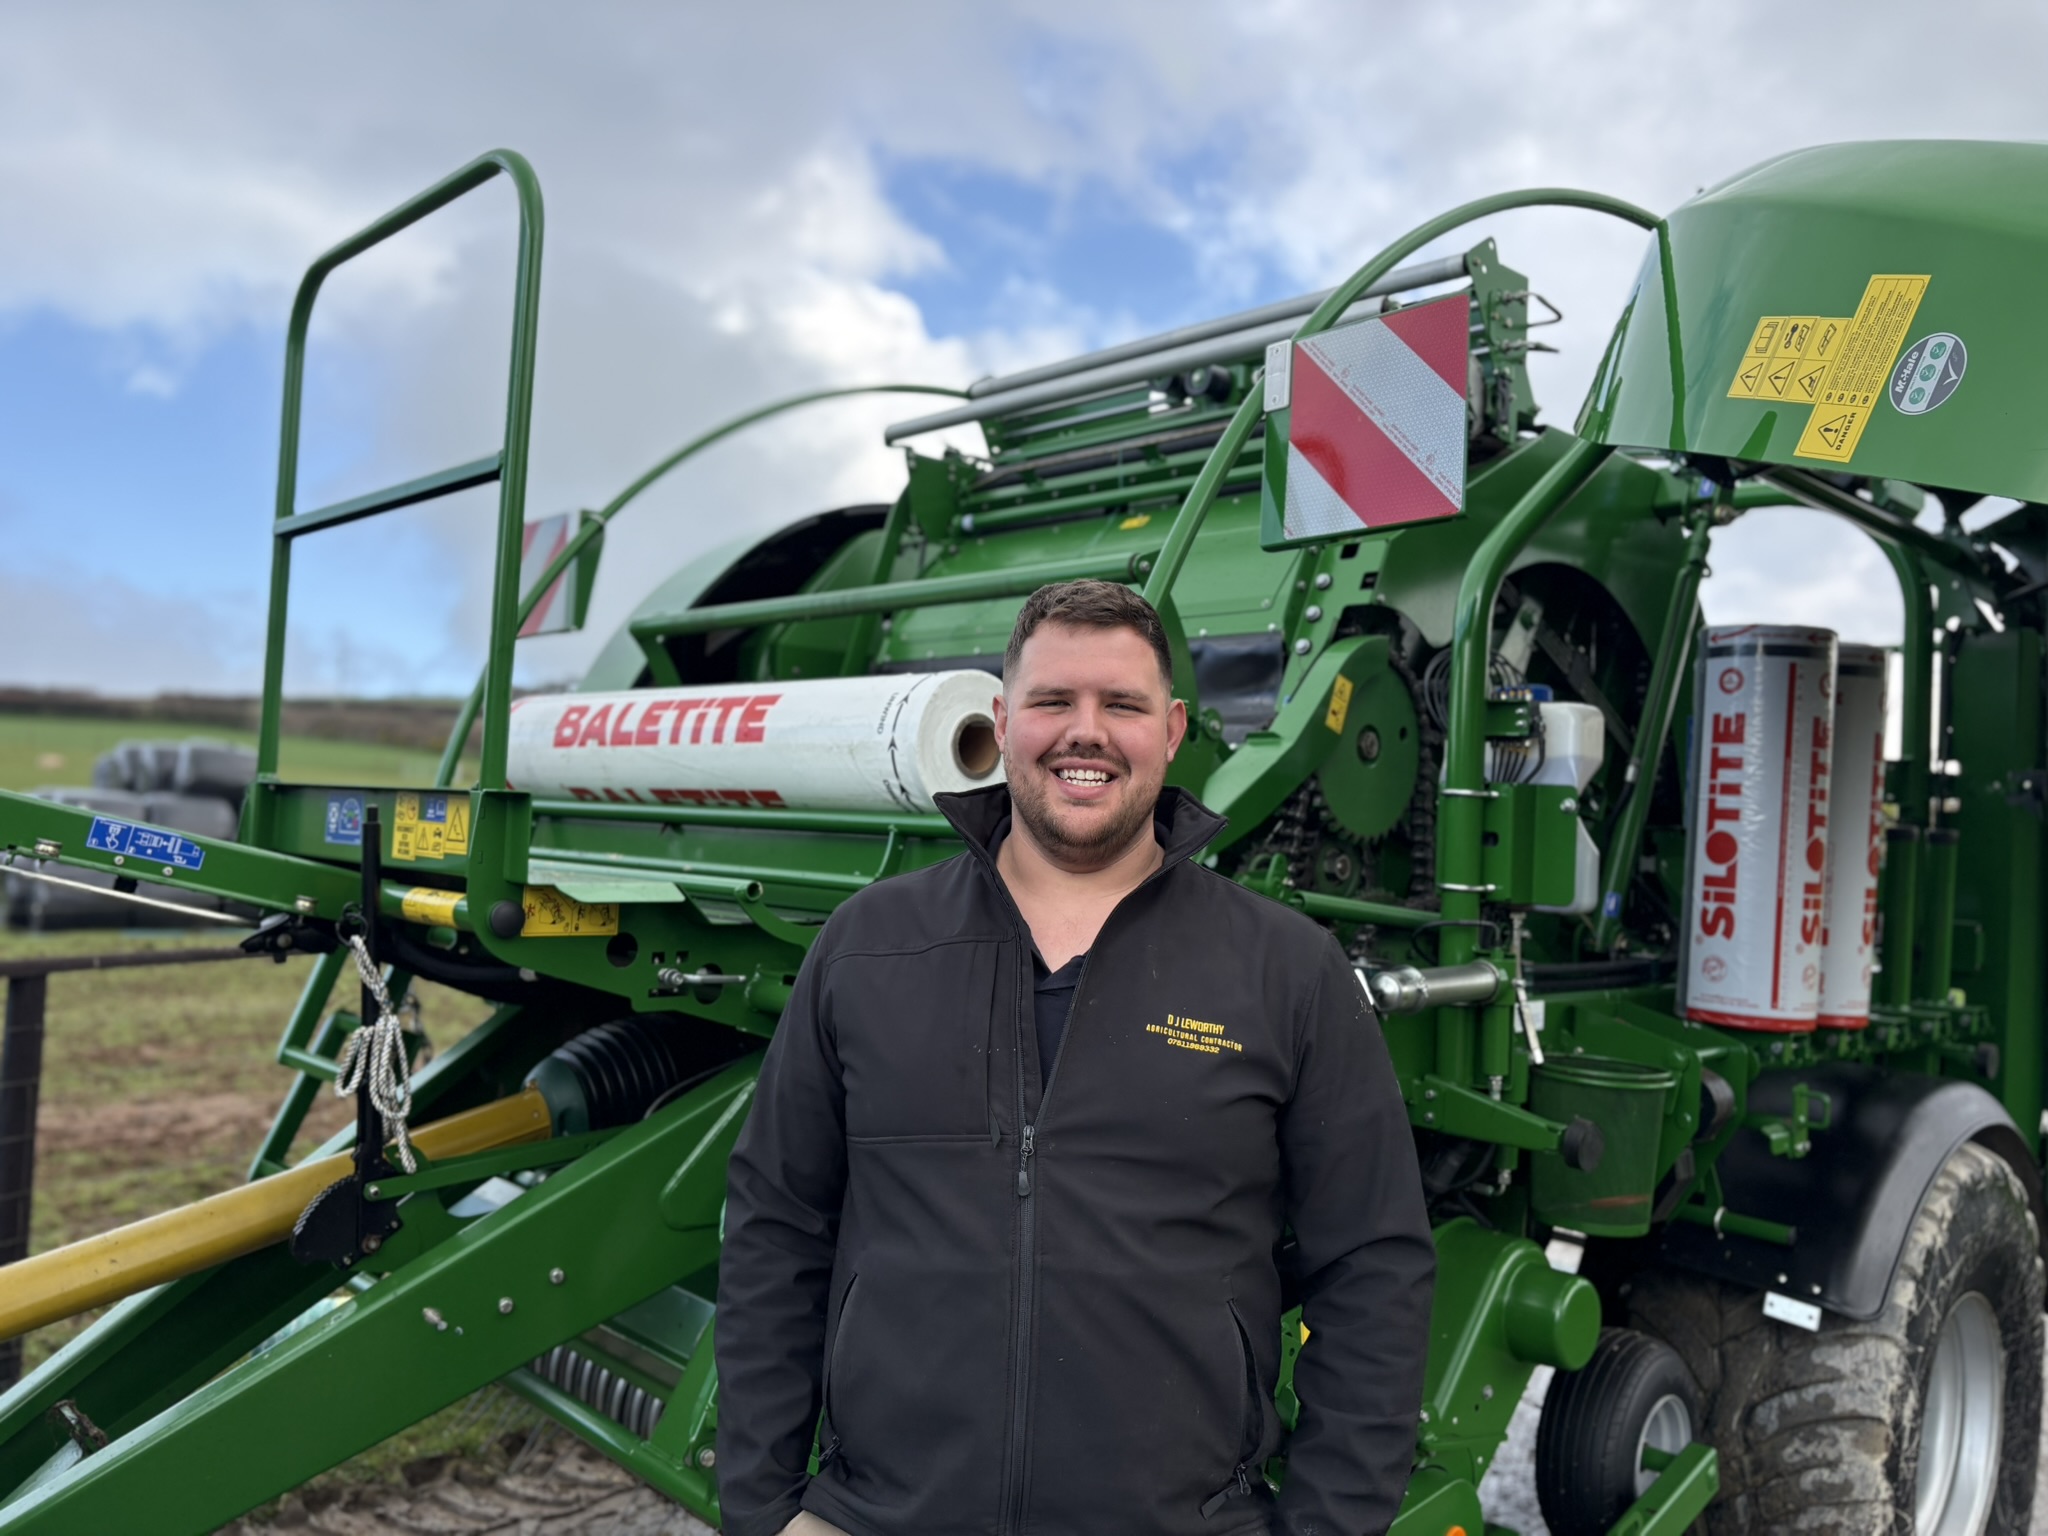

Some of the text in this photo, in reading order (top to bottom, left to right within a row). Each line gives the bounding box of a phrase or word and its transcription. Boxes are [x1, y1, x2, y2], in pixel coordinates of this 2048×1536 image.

[1894, 351, 1919, 393] McHale
[1835, 412, 1857, 450] DANGER
[1145, 1023, 1243, 1052] AGRICULTURAL CONTRACTOR
[1167, 1013, 1225, 1035] D J LEWORTHY
